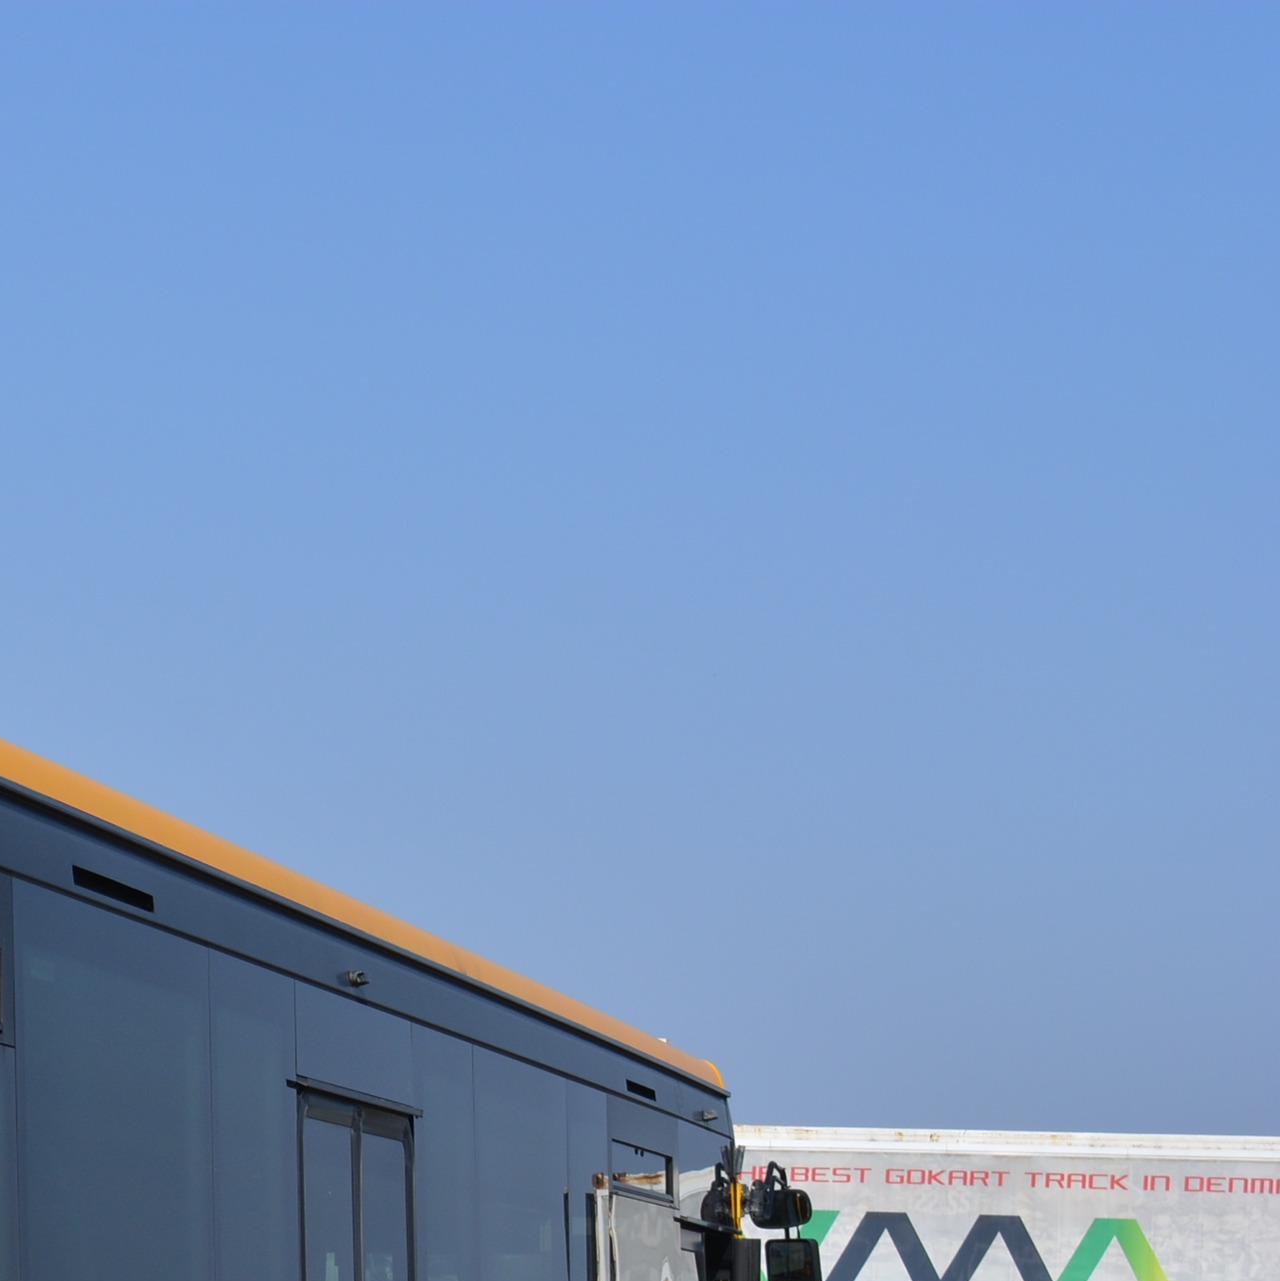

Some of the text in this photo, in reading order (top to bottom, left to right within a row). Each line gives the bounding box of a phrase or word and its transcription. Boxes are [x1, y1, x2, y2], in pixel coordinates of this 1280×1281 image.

[790, 1166, 872, 1184] BEST
[885, 1168, 1010, 1187] GOKART
[1024, 1171, 1129, 1191] TRACK
[1143, 1174, 1171, 1192] IN
[1184, 1175, 1280, 1195] DENM
